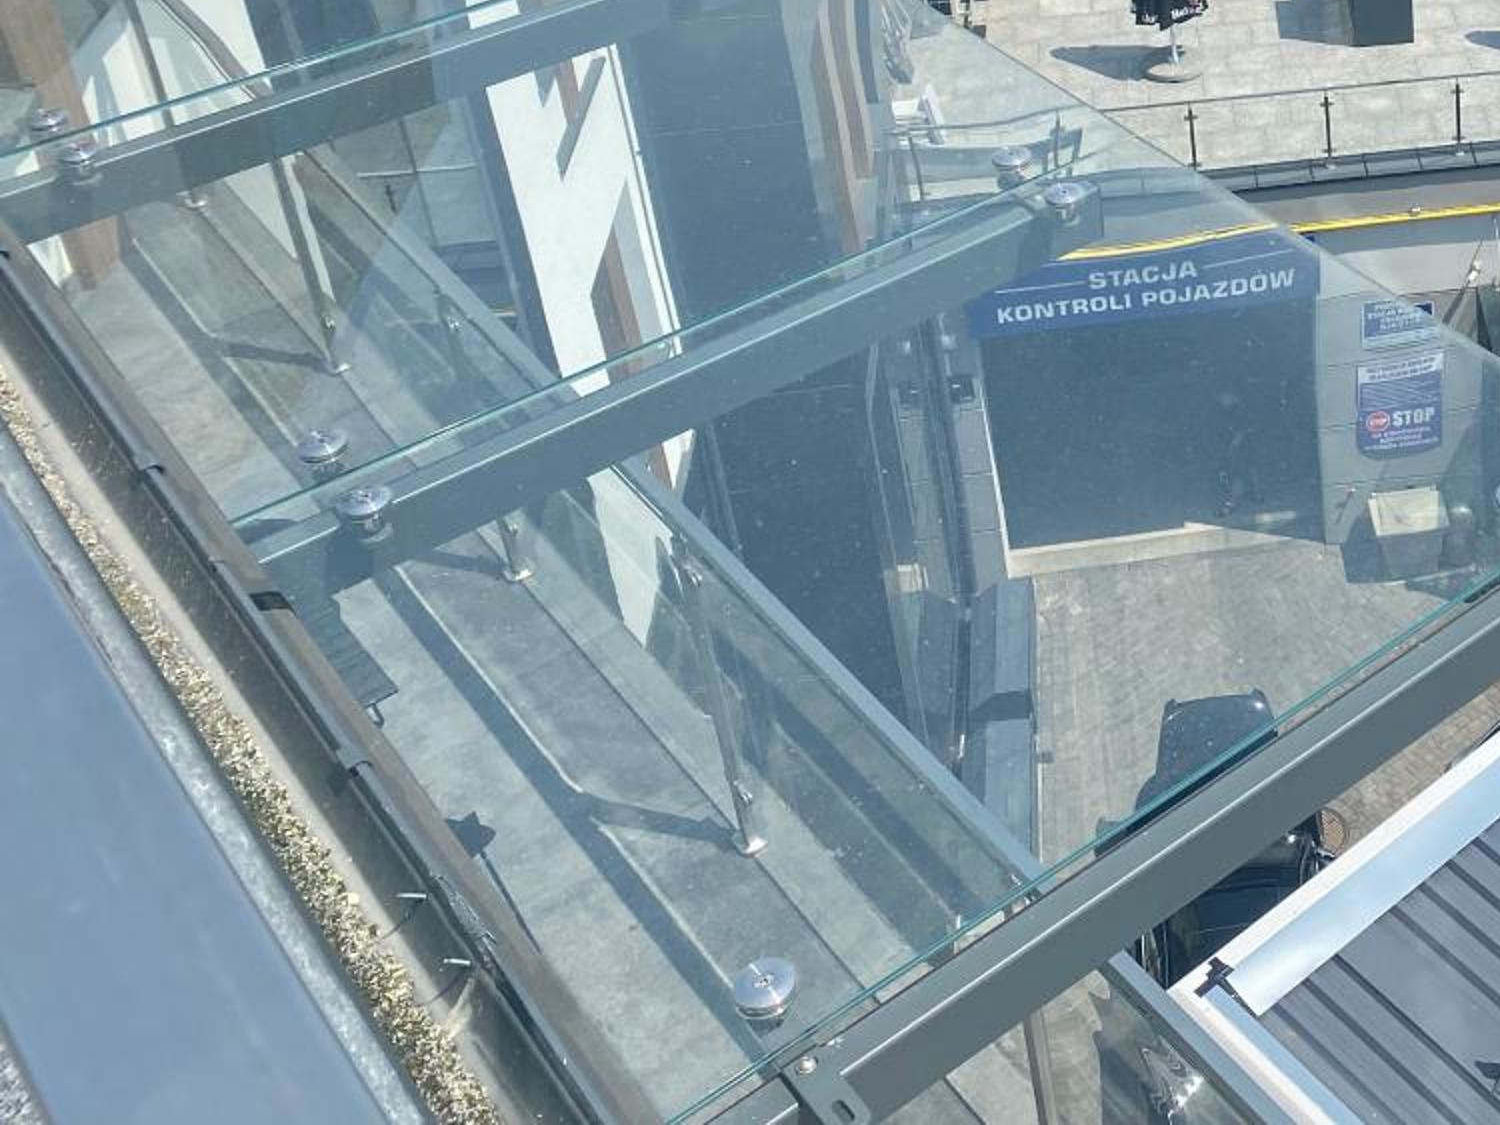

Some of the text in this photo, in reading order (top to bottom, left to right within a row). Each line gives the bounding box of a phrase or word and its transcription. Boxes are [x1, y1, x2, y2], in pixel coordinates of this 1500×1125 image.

[1089, 261, 1198, 290] STACJA
[997, 268, 1296, 324] KONTROLI POJAZDÓW
[1392, 407, 1435, 427] STOP
